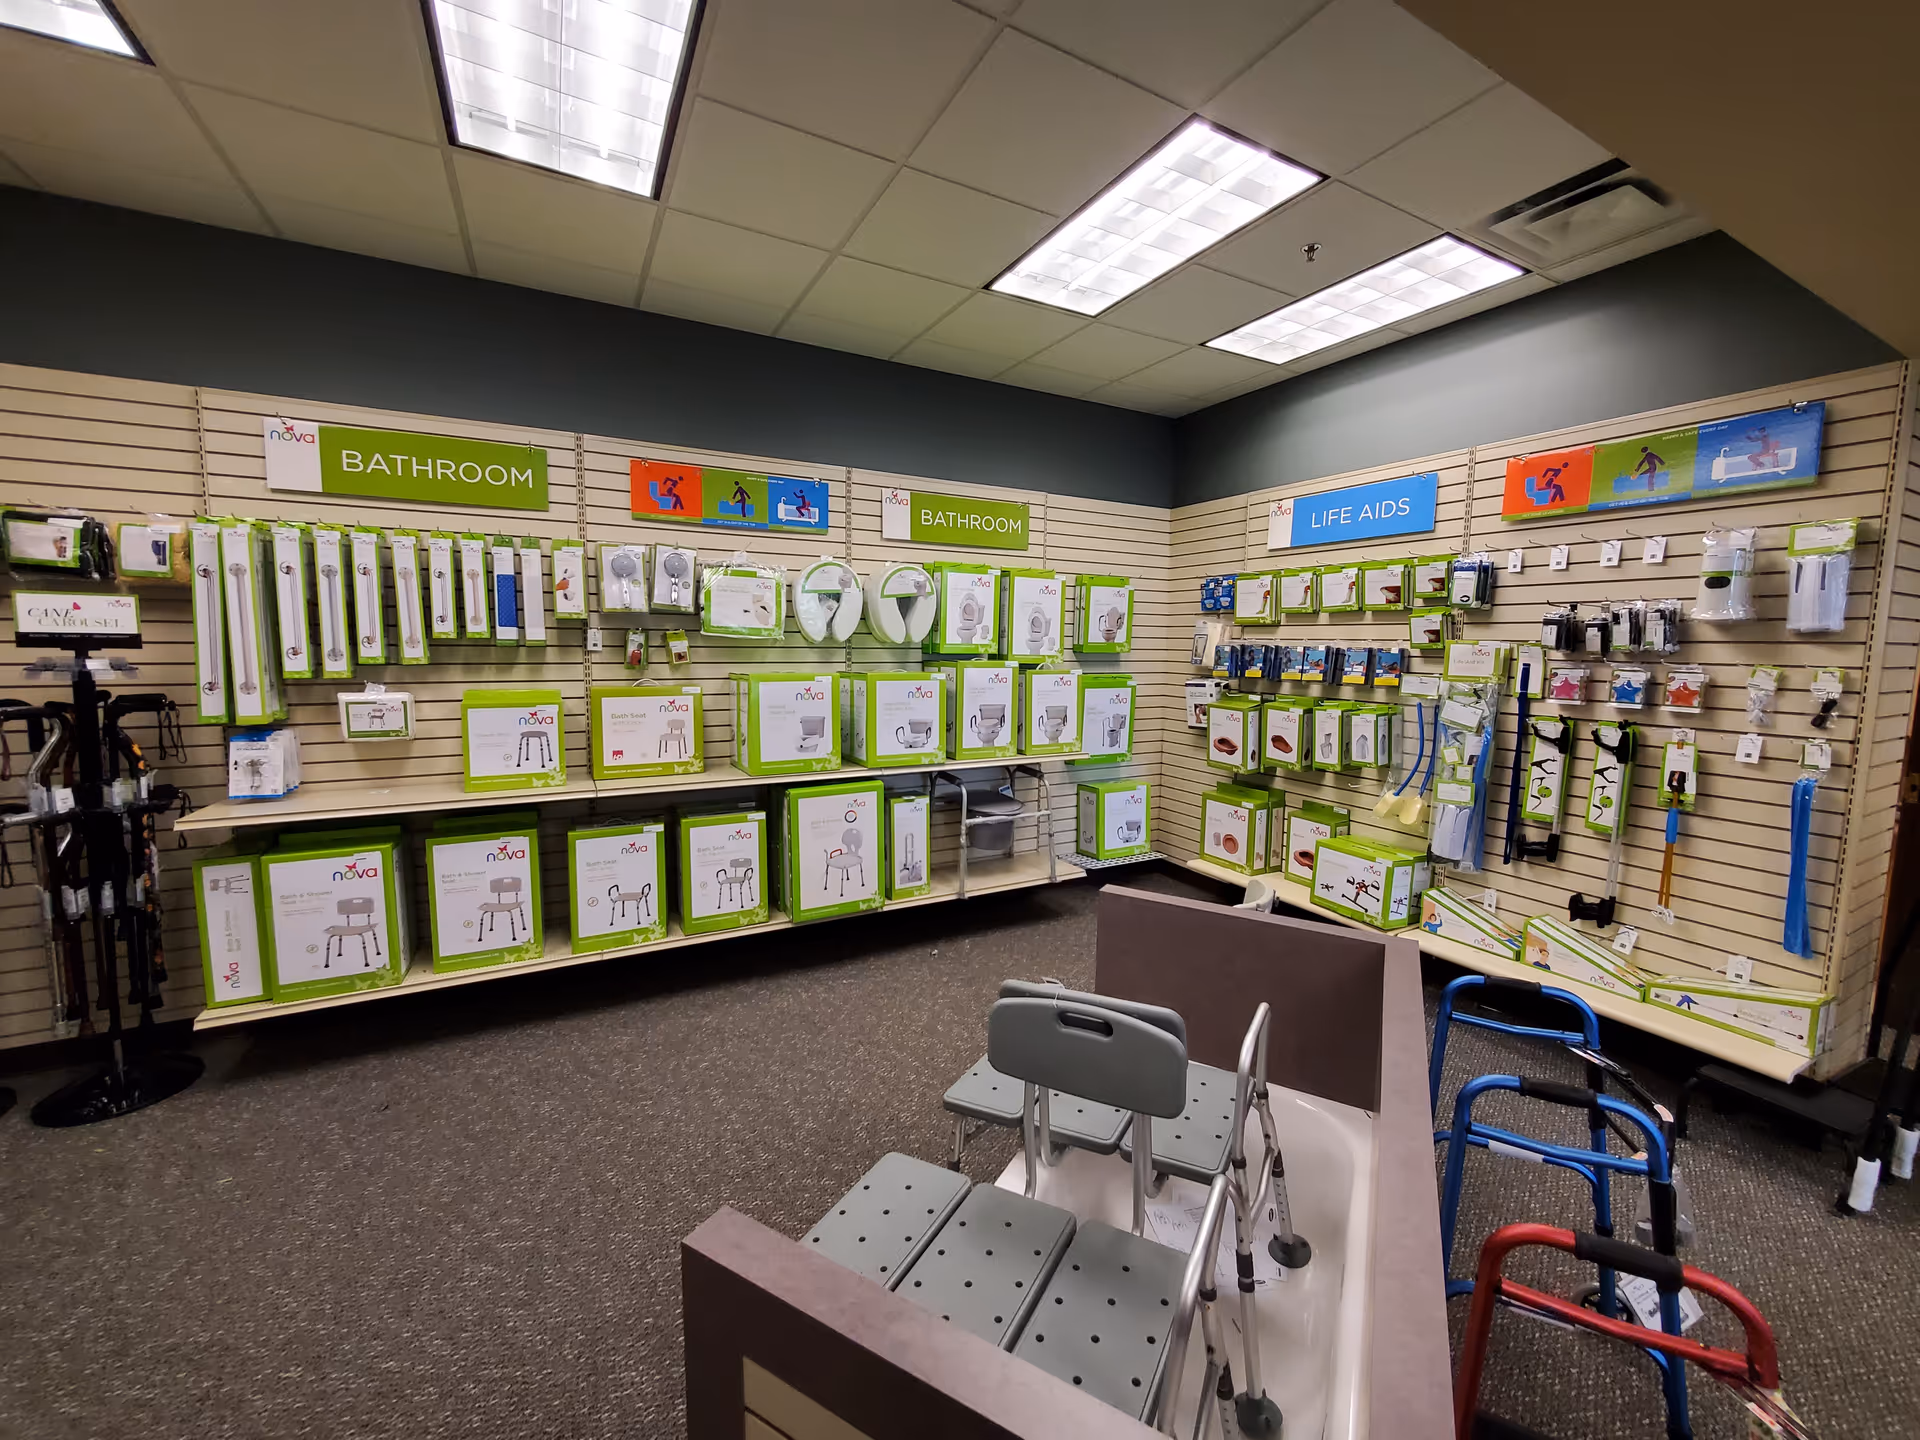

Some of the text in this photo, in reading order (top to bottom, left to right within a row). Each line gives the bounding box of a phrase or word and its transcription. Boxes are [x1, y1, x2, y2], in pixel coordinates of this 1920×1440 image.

[270, 429, 315, 444] nova
[341, 449, 534, 489] BATHROOM
[885, 495, 909, 506] nova
[1271, 507, 1291, 518] nova
[1311, 497, 1410, 529] LIFE AIDS
[921, 509, 1022, 534] BATHROOM
[972, 579, 990, 588] nova
[1039, 587, 1056, 596] nova
[28, 608, 74, 618] CANE
[38, 617, 125, 628] CAROUSEL
[989, 676, 1007, 684] nova
[1054, 678, 1071, 687] nova
[796, 691, 824, 701] nova
[908, 690, 932, 699] nova
[1110, 696, 1127, 705] nova
[659, 703, 689, 713] nova
[519, 715, 553, 726] nova
[611, 712, 629, 720] Bath
[1226, 715, 1240, 723] nova
[1282, 716, 1297, 724] nova
[848, 801, 866, 809] nova
[1228, 811, 1246, 822] nova
[728, 832, 752, 841] nova
[1310, 827, 1327, 837] nova
[486, 848, 525, 862] nova
[621, 844, 648, 855] nova
[332, 867, 378, 881] nova
[1364, 866, 1381, 877] nova
[1473, 938, 1494, 950] nova
[228, 961, 241, 989] nova
[1590, 975, 1616, 990] nova
